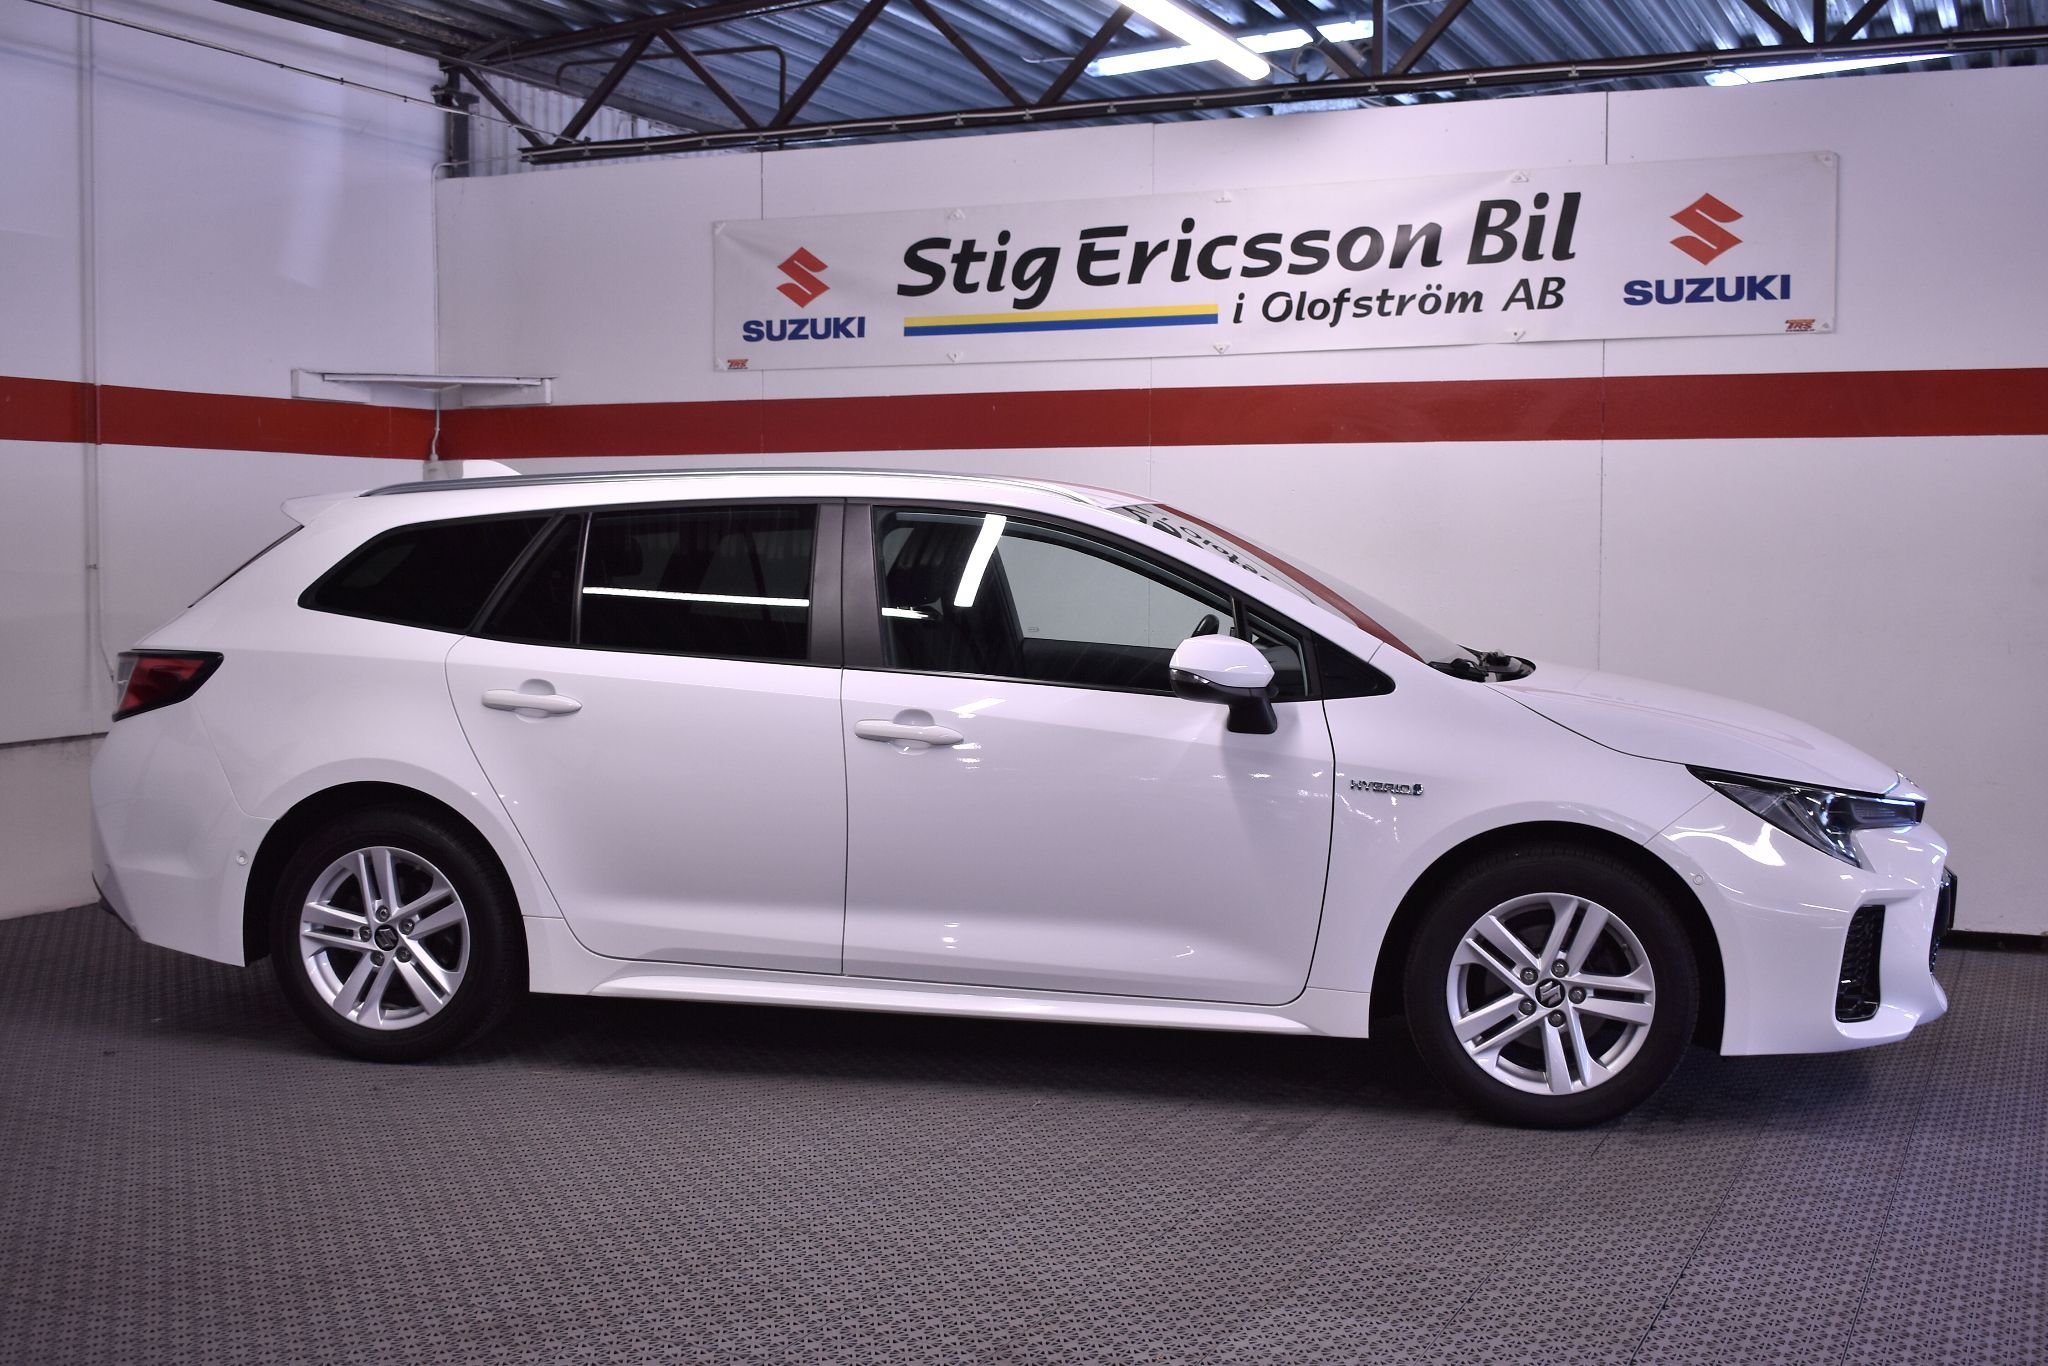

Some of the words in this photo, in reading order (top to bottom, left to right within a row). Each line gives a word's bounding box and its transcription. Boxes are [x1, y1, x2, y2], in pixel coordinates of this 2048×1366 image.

[897, 229, 1061, 310] Stig
[1076, 217, 1443, 287] Ericsson
[1467, 191, 1582, 265] Bil
[1232, 292, 1245, 324] i
[1261, 283, 1483, 328] Olofström
[1503, 276, 1566, 312] AB
[1624, 274, 1791, 306] SUZUKI
[742, 316, 866, 343] SUZUKI
[1350, 780, 1411, 796] HYBRID
